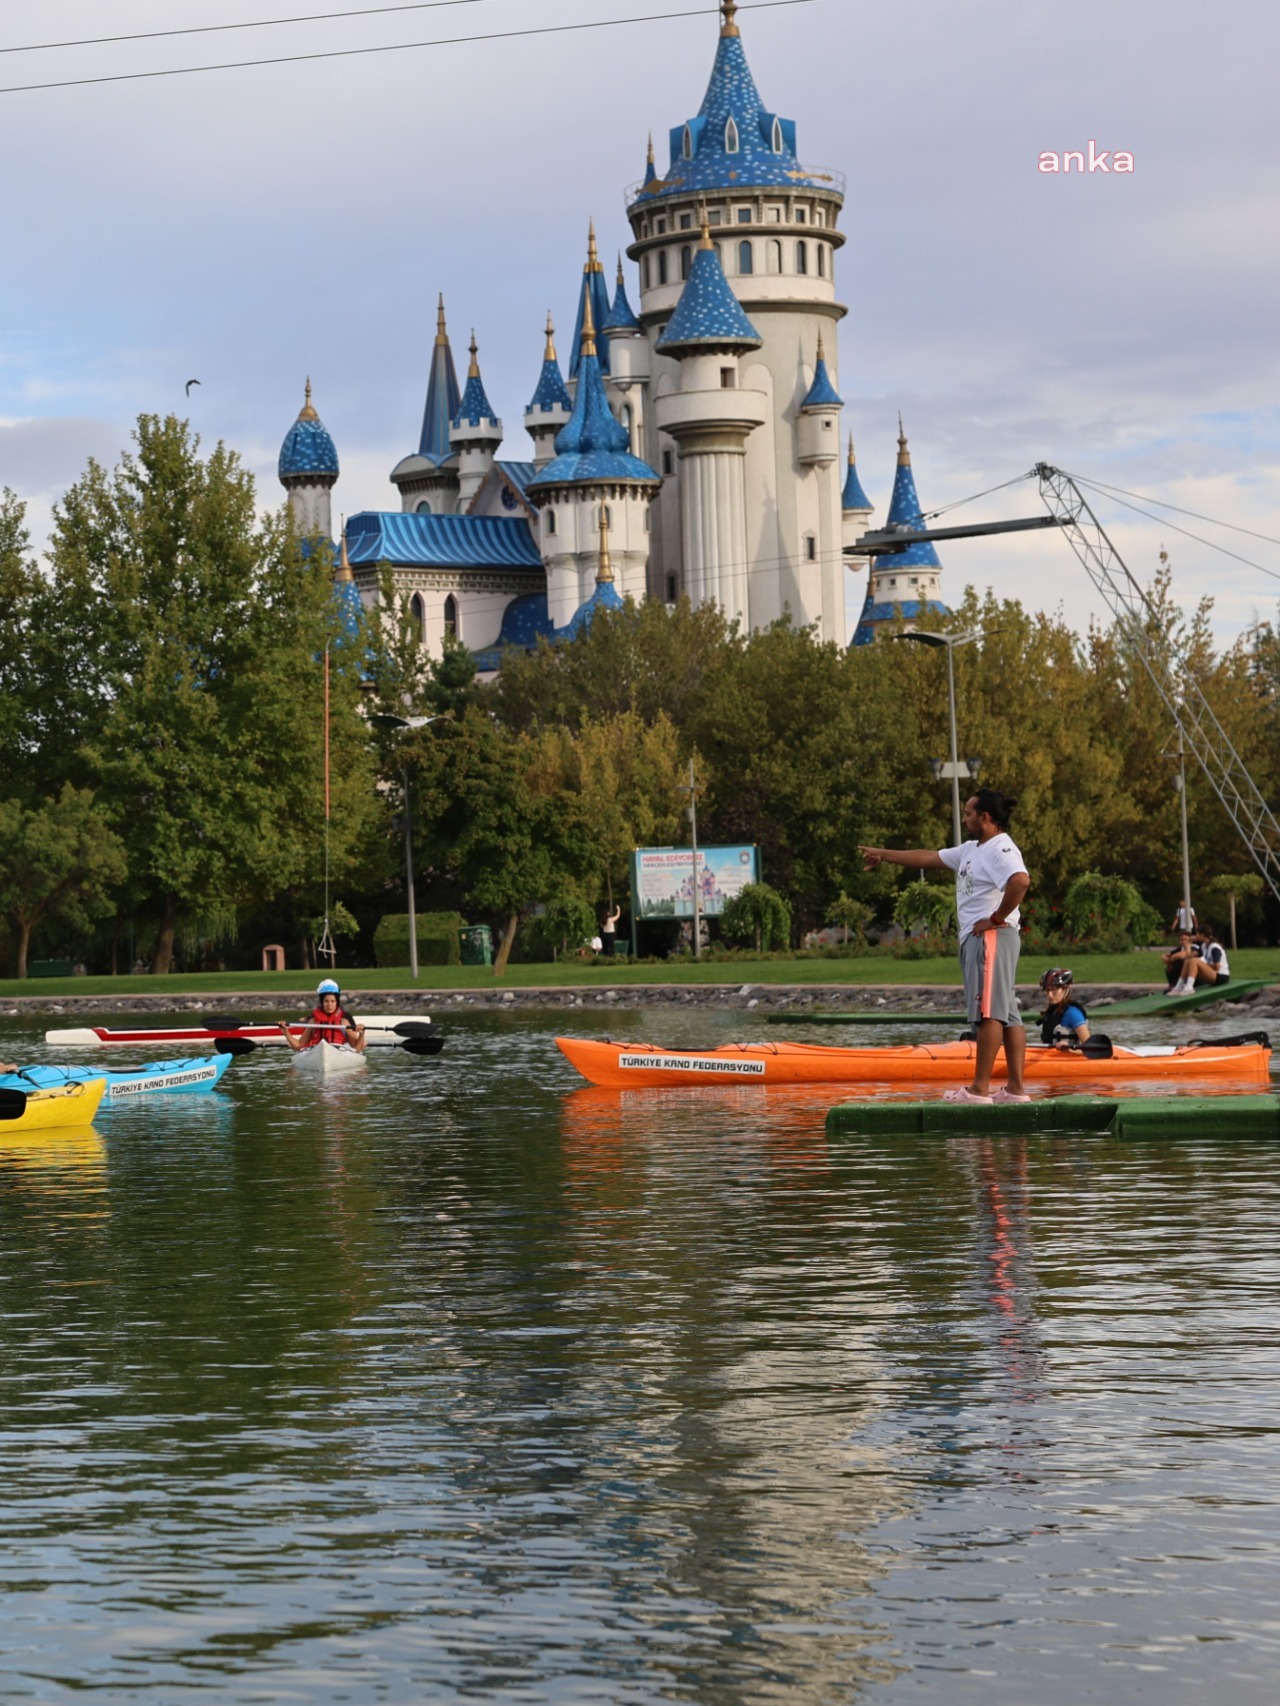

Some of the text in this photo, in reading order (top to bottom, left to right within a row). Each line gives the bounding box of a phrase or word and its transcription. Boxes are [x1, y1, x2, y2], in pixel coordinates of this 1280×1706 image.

[621, 1056, 763, 1073] TÜRKİYE KANO FEDERASYONU
[112, 1069, 215, 1094] TÜRKİYE KANO FEDERASYONU
